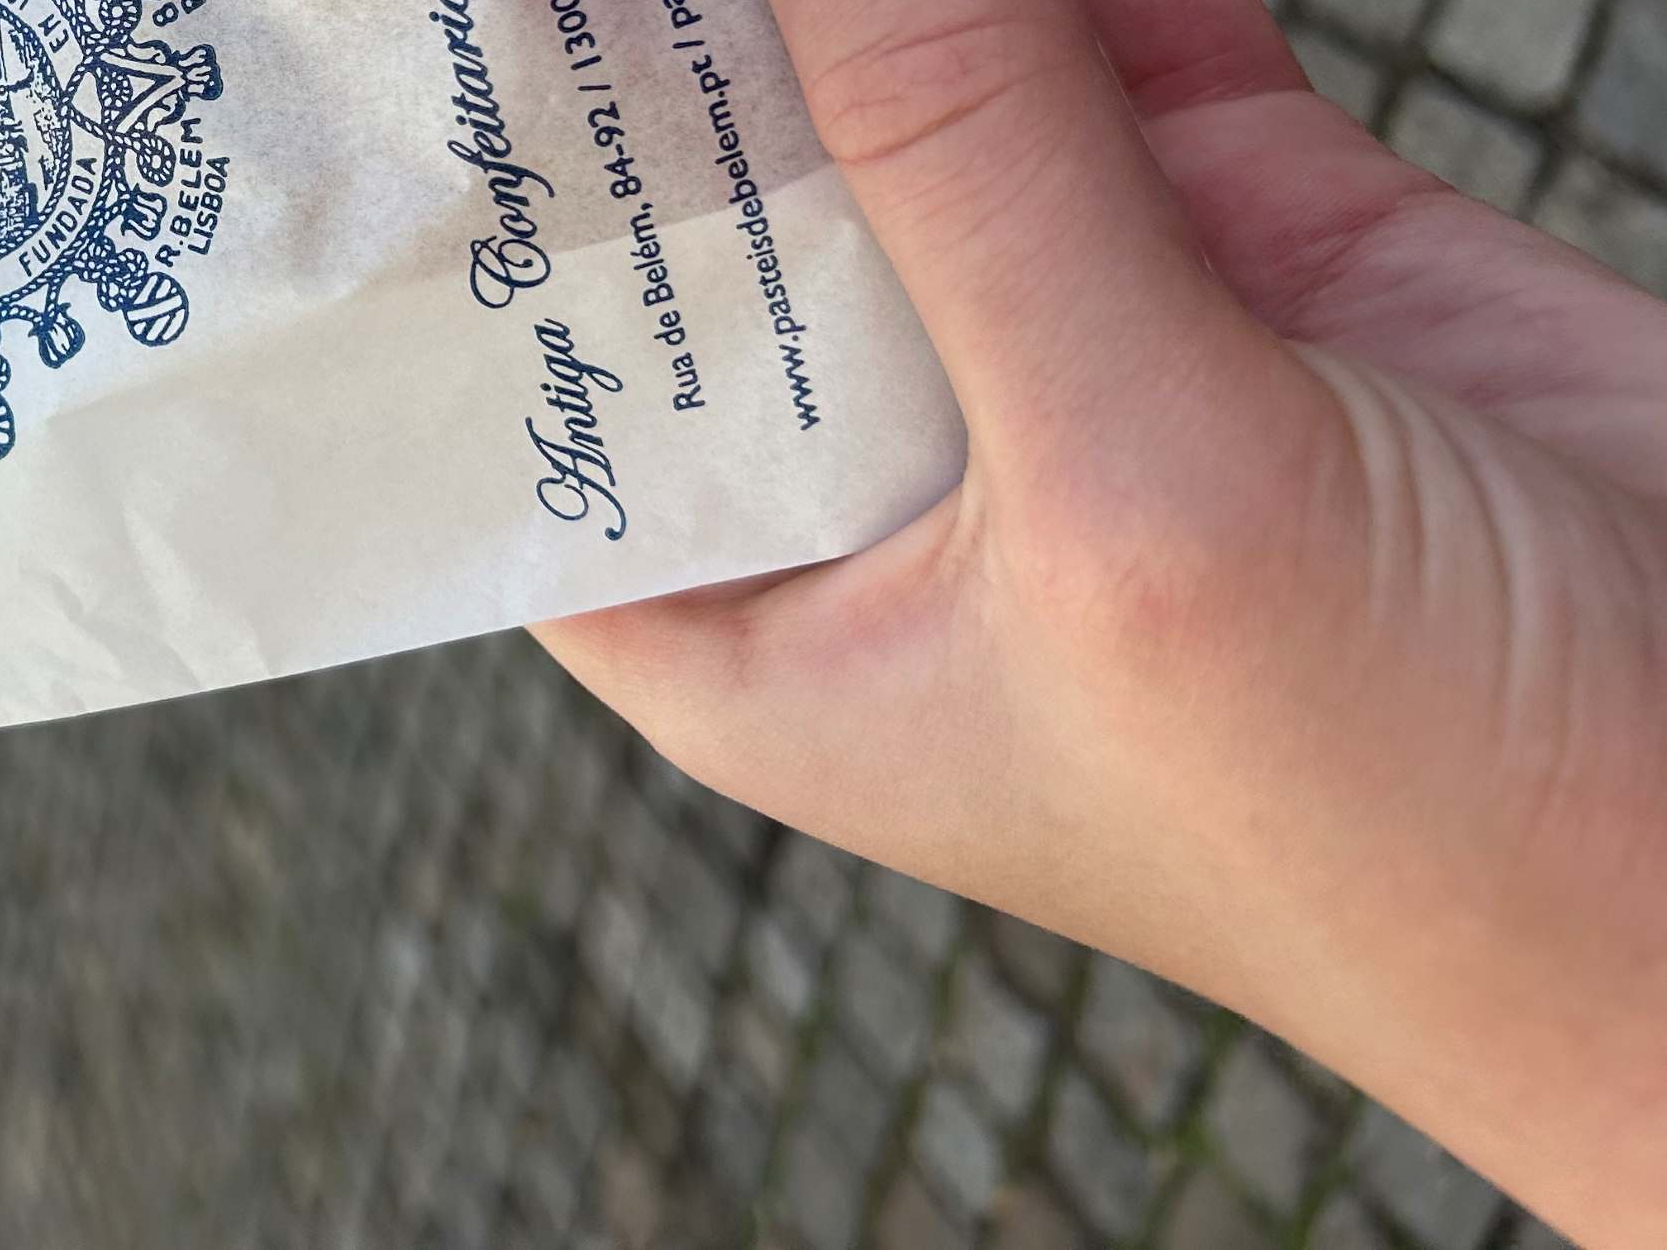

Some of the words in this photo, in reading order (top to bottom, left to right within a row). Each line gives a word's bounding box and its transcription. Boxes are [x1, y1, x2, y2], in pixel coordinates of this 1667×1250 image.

[587, 100, 642, 199] 84-92
[19, 156, 99, 277] FUNDADA
[189, 156, 230, 255] LISBOA
[629, 202, 674, 308] Belém,
[692, 53, 821, 431] www.pasteisdebelem.pt
[653, 310, 687, 347] de
[525, 317, 626, 541] Antiga
[672, 352, 705, 411] Rua
